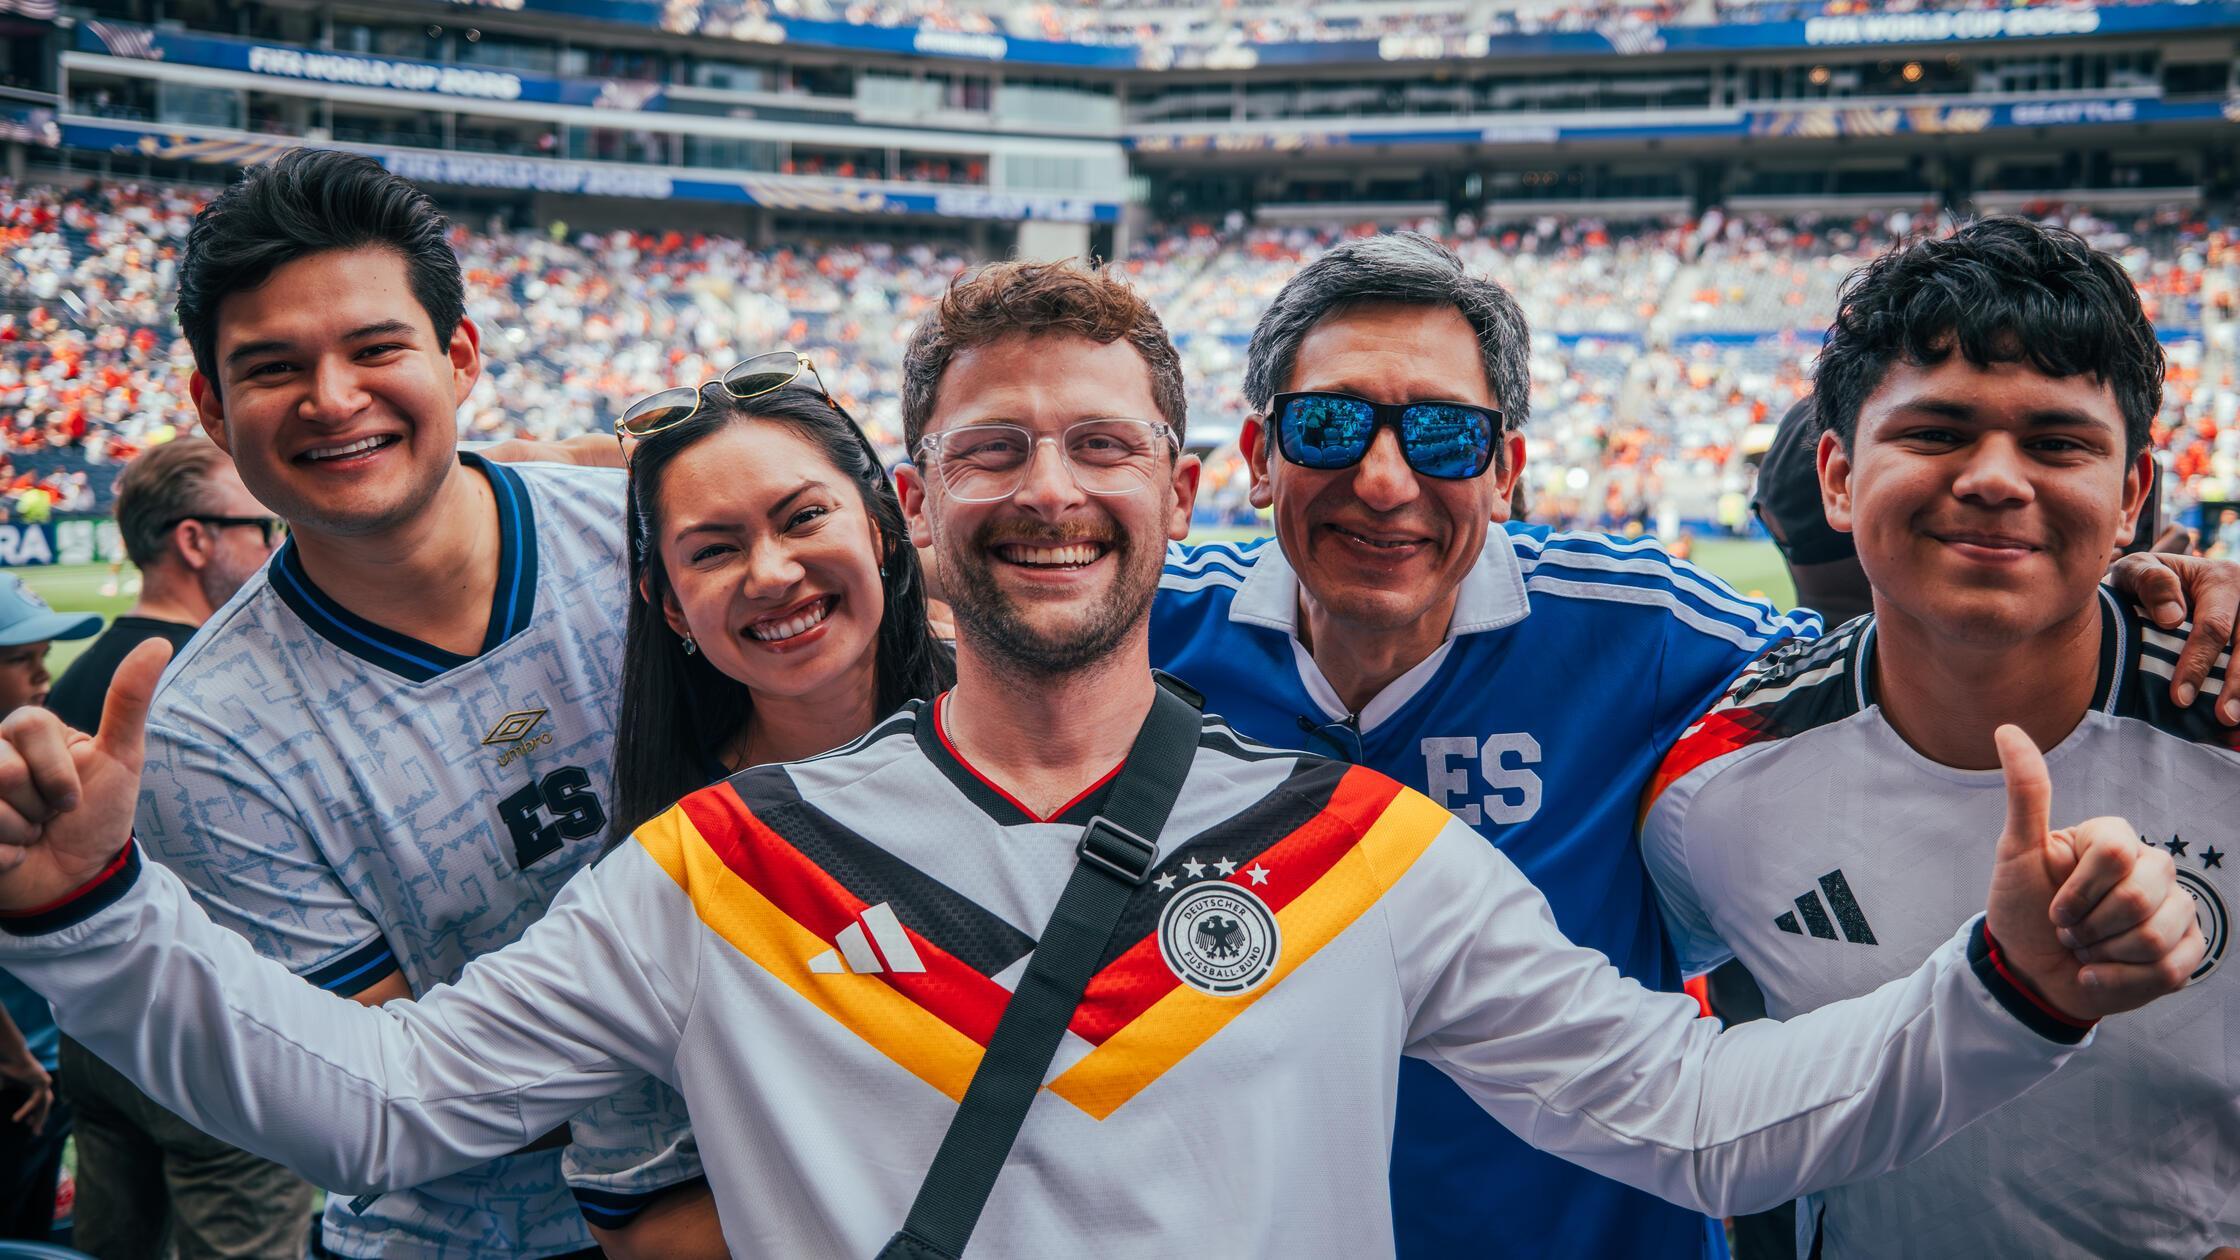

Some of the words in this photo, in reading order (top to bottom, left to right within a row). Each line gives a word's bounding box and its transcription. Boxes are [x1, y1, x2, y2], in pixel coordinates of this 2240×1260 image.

[249, 46, 302, 76] FIFA
[303, 53, 390, 86] WORLD
[389, 63, 440, 90] CUP
[497, 732, 553, 767] umbro
[1420, 732, 1543, 825] ES
[497, 766, 607, 870] ES
[1184, 898, 1247, 920] DEUTSCHER
